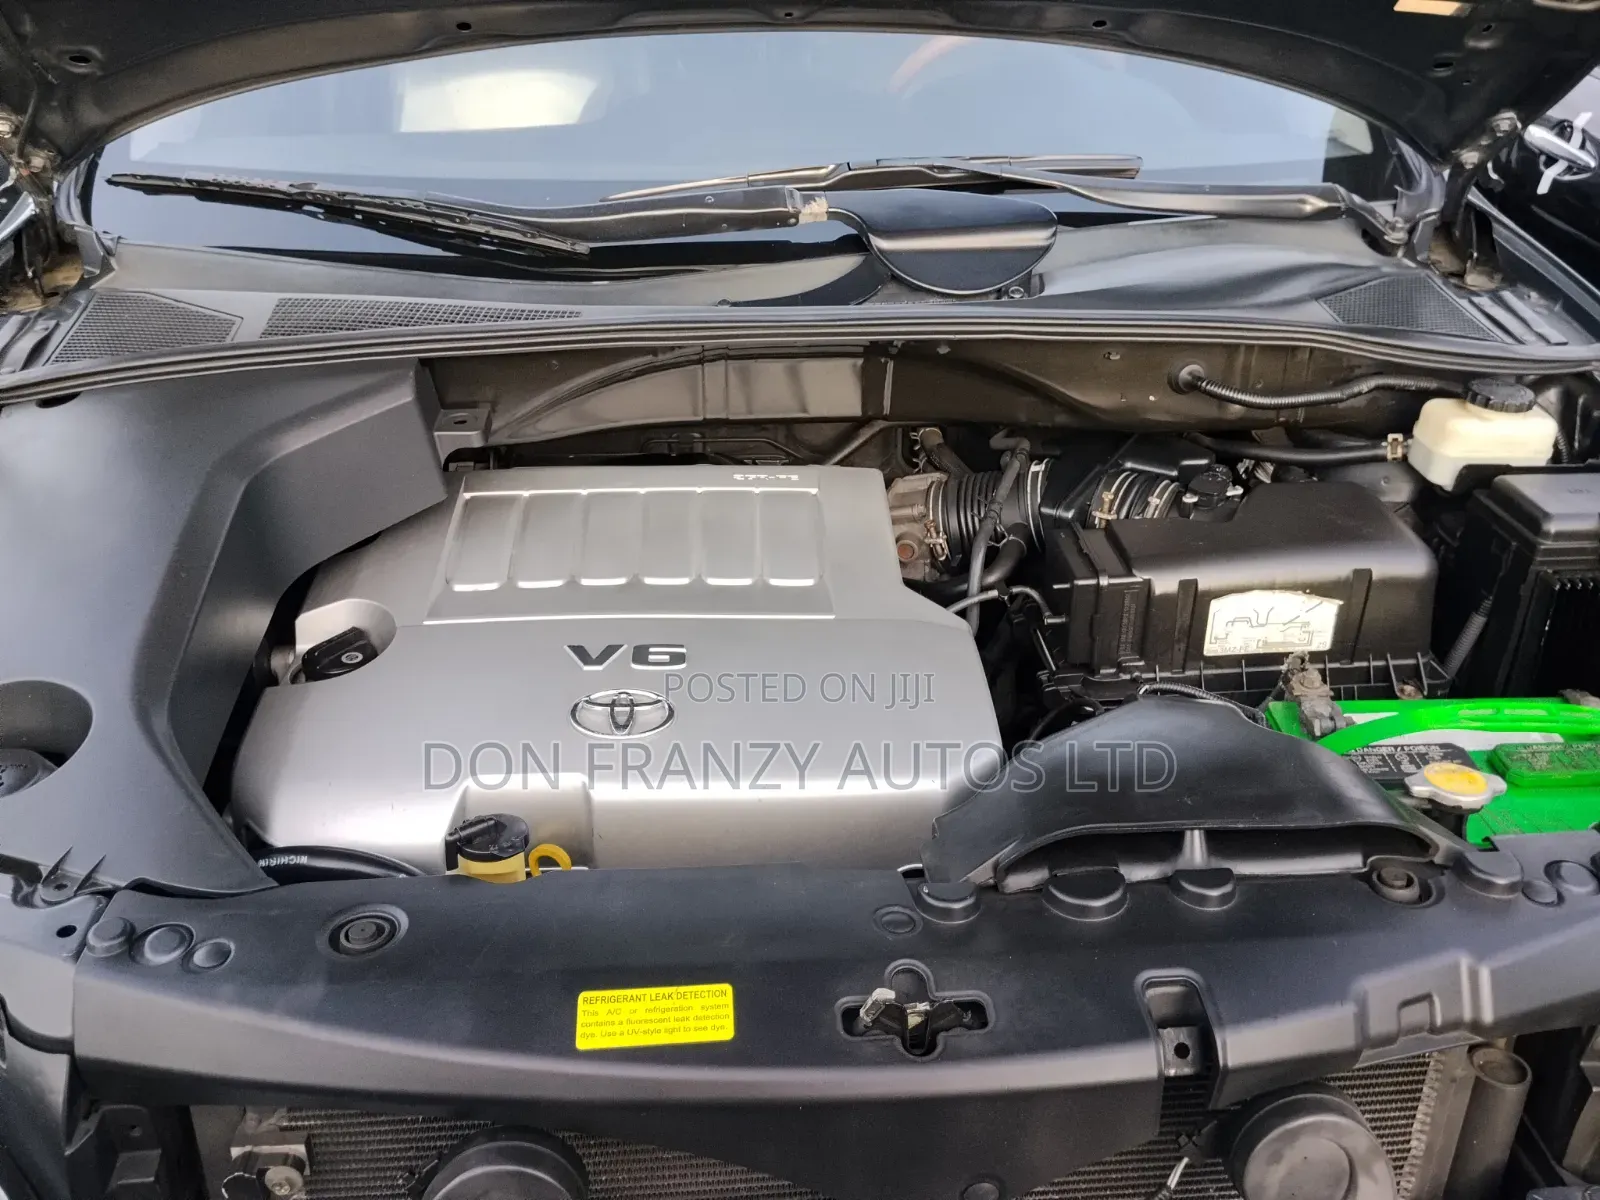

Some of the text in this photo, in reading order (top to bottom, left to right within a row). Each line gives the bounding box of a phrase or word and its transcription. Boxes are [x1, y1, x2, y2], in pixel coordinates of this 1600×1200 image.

[563, 643, 687, 671] V6
[582, 989, 727, 1005] REFRIGERANT LEAK DETECTION
[581, 1009, 599, 1017] This
[606, 1008, 622, 1016] A/C
[644, 1005, 693, 1014] refrigeration
[700, 1003, 729, 1011] system
[580, 1020, 616, 1028] contains
[626, 1016, 671, 1025] fluorescent
[693, 1013, 730, 1021] detection
[580, 1032, 598, 1040] dye.
[600, 1029, 617, 1037] Use
[626, 1027, 662, 1036] UV-style
[664, 1026, 681, 1034] light
[711, 1023, 728, 1032] dye.
